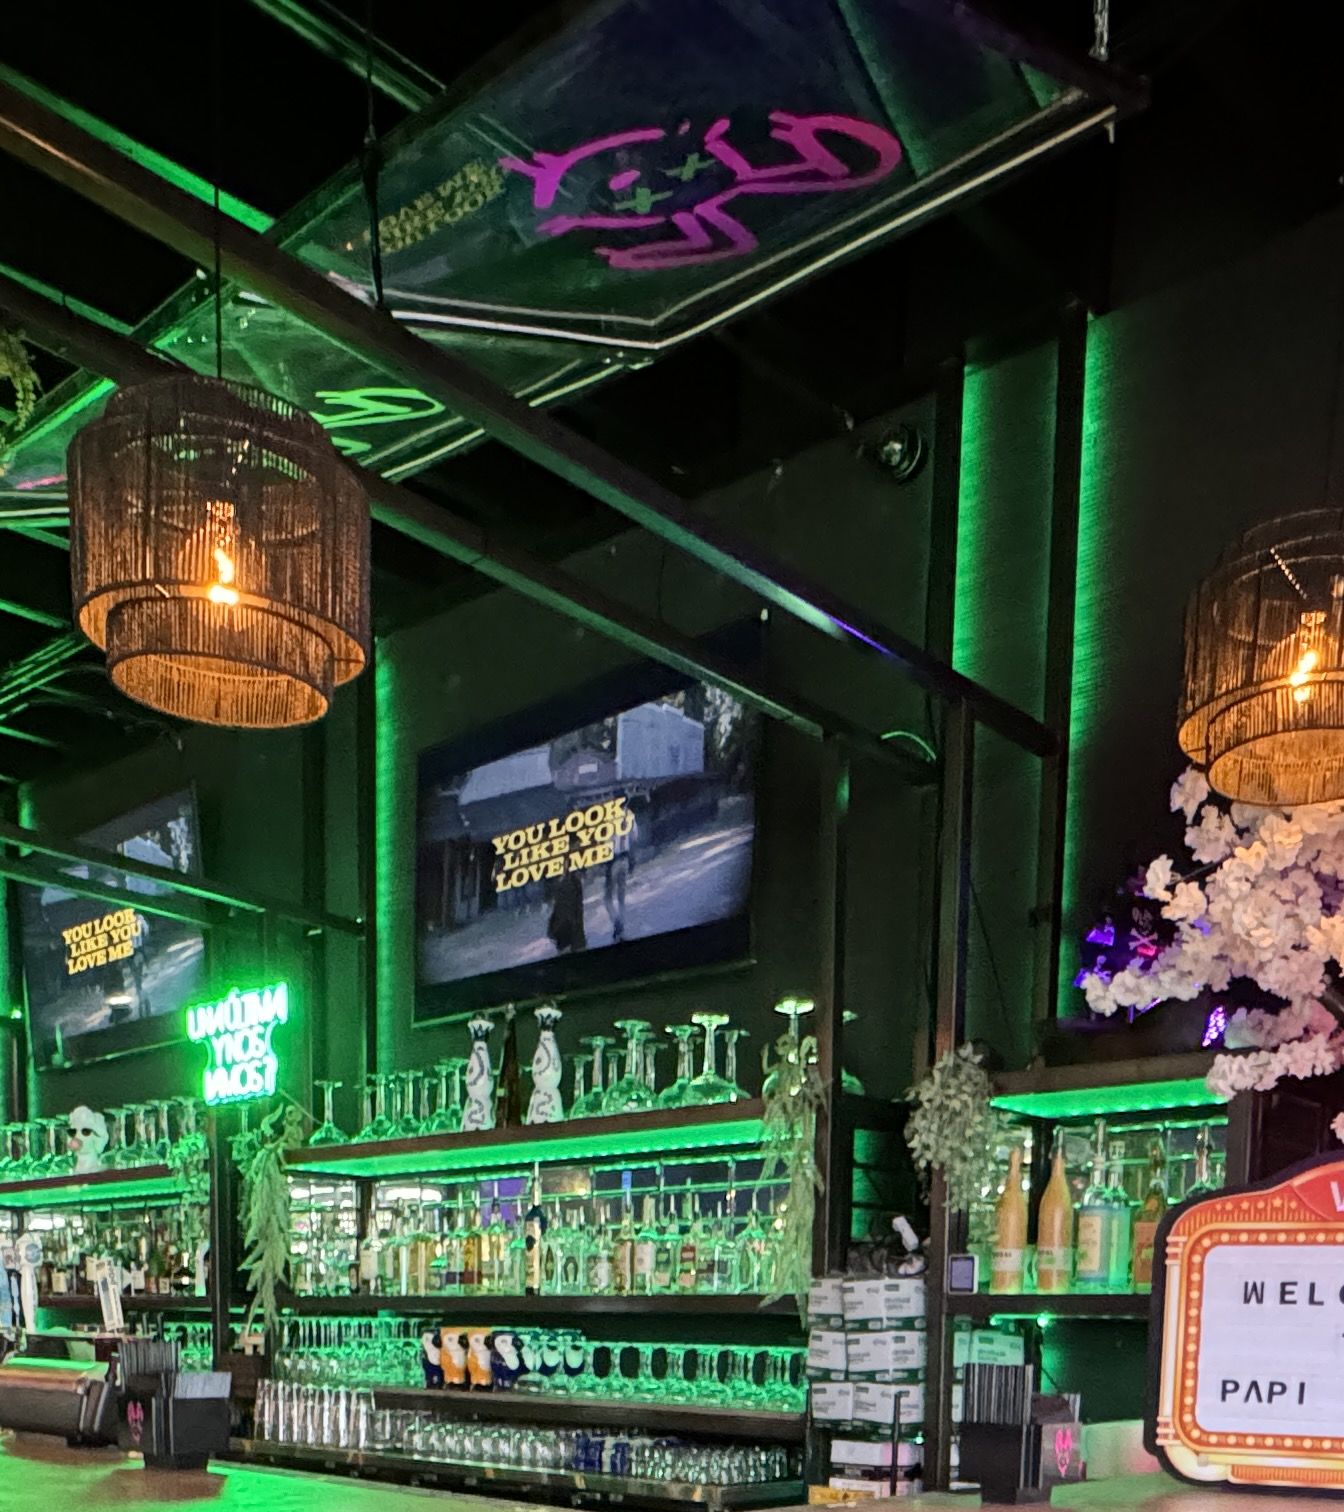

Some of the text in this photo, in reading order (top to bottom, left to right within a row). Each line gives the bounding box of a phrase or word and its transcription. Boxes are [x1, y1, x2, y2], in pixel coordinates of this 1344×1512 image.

[492, 797, 626, 855] YOU LOOK
[503, 814, 634, 871] LIKE YOU
[496, 841, 614, 893] LOVE ME
[62, 908, 135, 944] YOU LOOK
[70, 920, 141, 957] LIKE YOU
[68, 941, 134, 975] LOVE ME
[1220, 1379, 1307, 1406] PAPI
